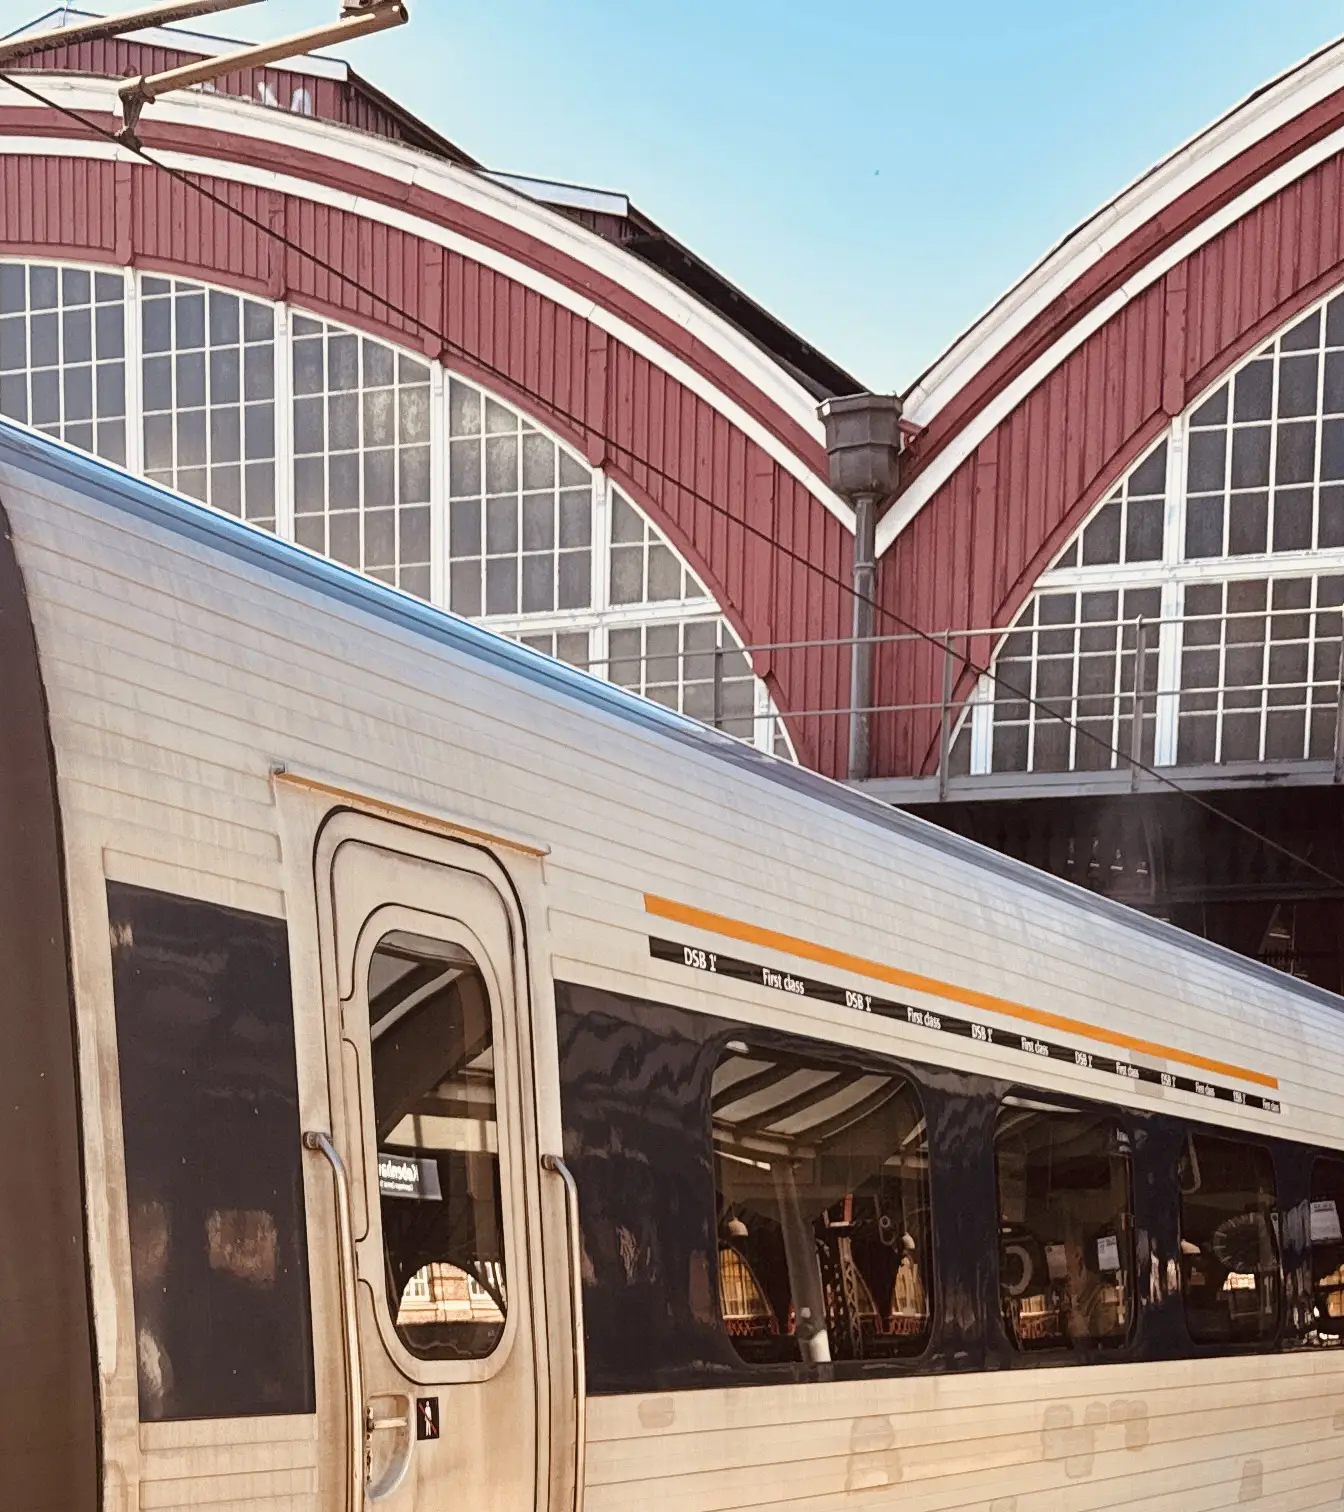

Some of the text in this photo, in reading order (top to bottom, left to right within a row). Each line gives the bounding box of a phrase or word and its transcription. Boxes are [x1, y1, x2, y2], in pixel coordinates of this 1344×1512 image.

[683, 947, 707, 969] DSB
[762, 968, 783, 989] First
[783, 974, 805, 995] class
[845, 990, 864, 1010] DSB
[907, 1007, 923, 1025] First
[923, 1011, 941, 1030] class
[971, 1024, 987, 1041] DSB
[1021, 1036, 1035, 1052] First
[1035, 1040, 1049, 1057] class
